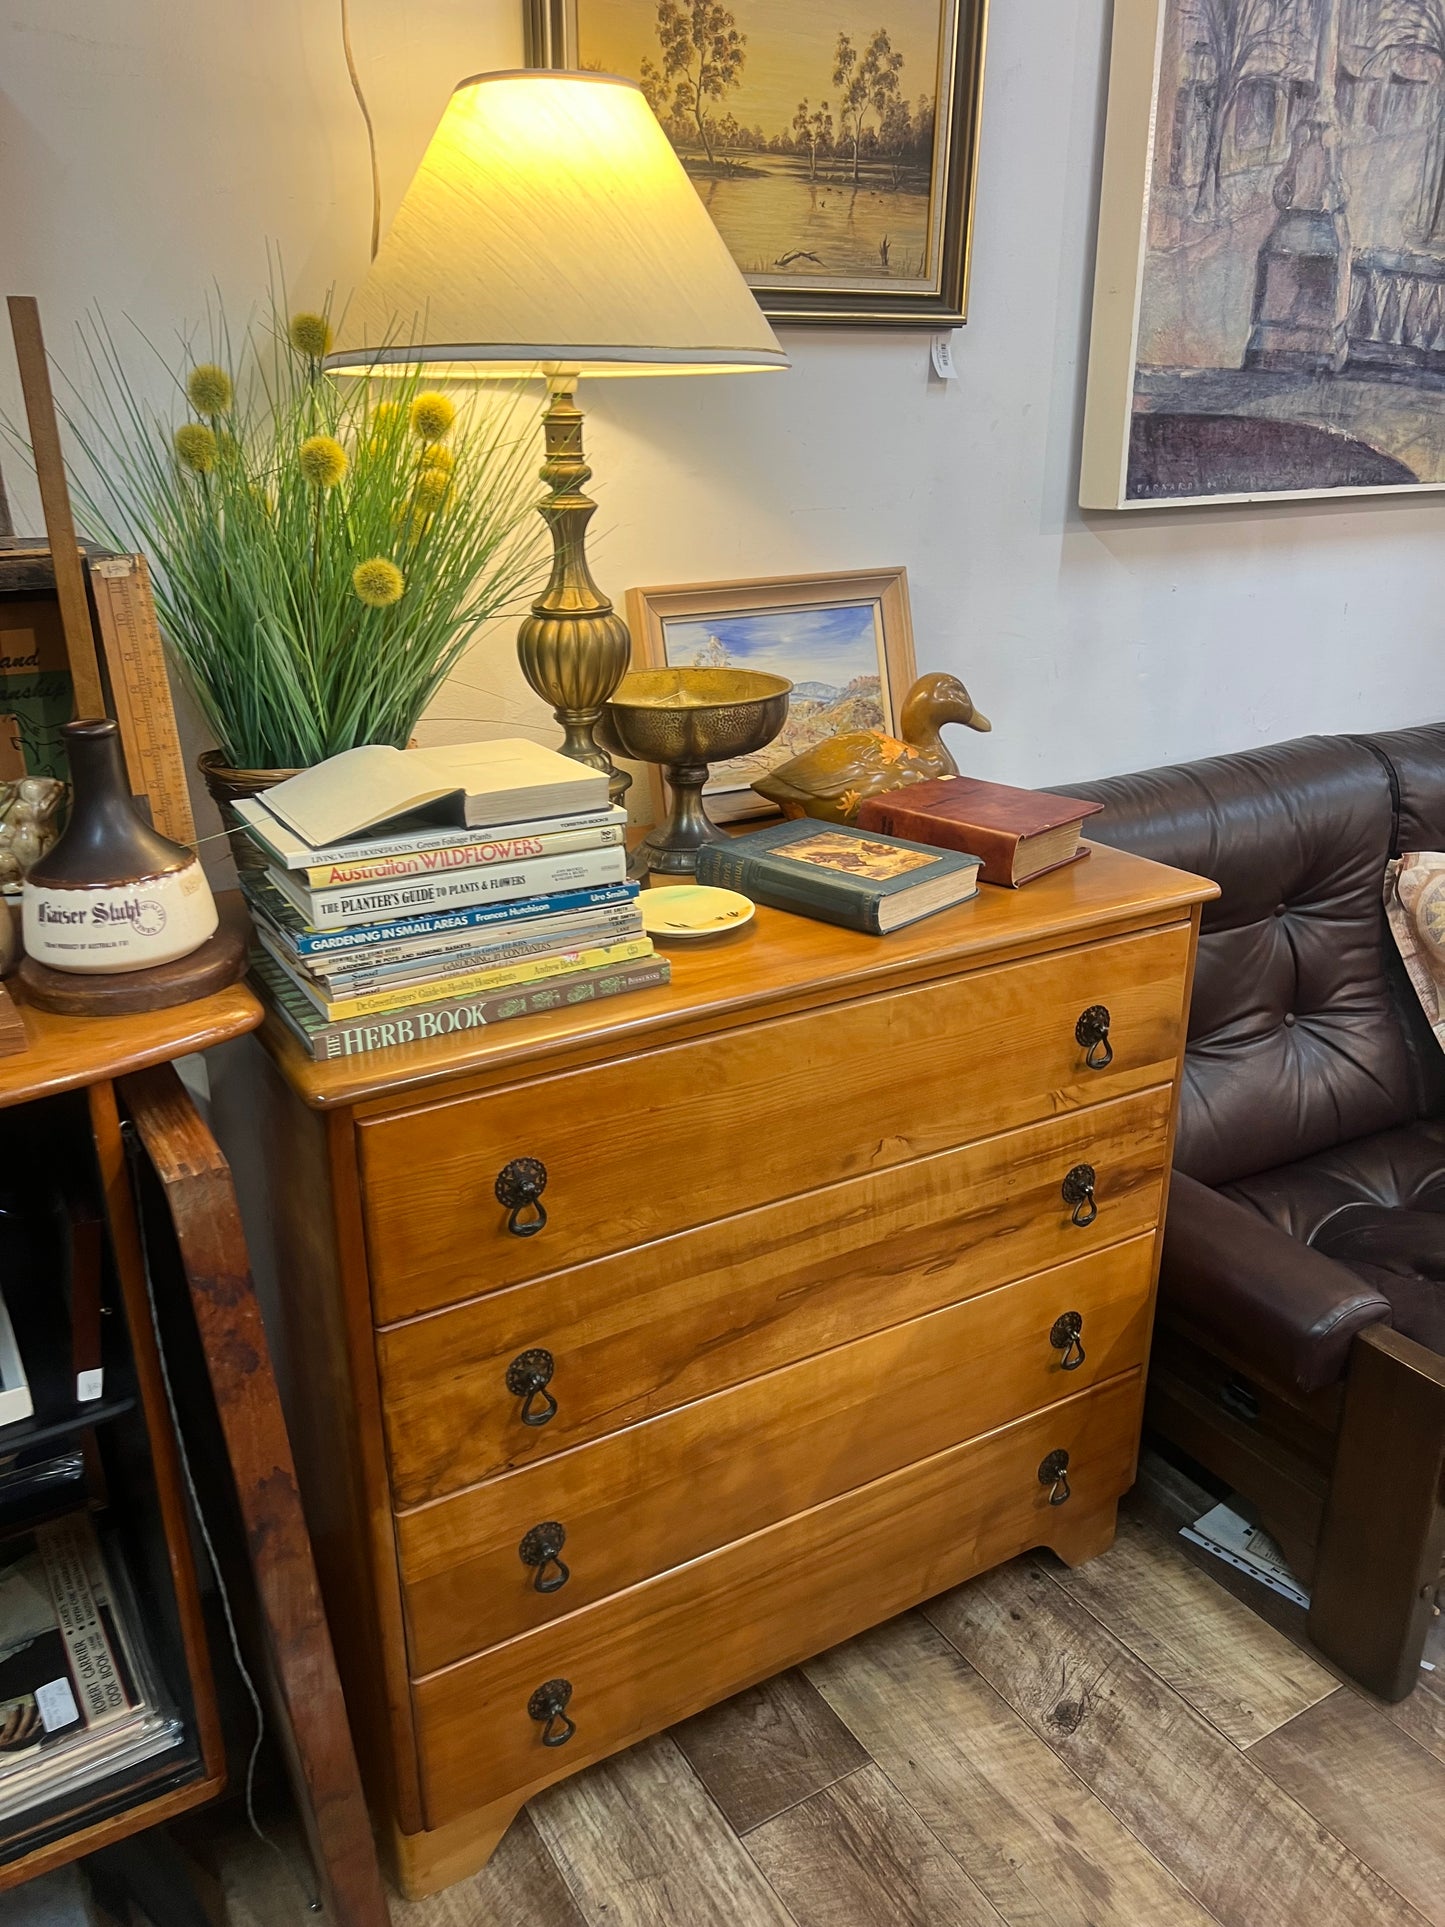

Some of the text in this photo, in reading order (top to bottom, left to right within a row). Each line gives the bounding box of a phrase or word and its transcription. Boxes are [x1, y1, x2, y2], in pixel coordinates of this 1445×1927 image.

[417, 840, 440, 850] Green
[442, 833, 468, 845] Foliage
[469, 832, 492, 842] Plants
[329, 838, 544, 884] Australian WILDFLOWERS
[321, 875, 526, 914] THE PLANTER'S GUIDE TO PLANTS & FLOWERS
[92, 899, 141, 926] Stuhl
[310, 888, 629, 951] GARDENING IN SMALL AREAS Frances Hutchison Ure Smith
[337, 961, 373, 971] GARDENING
[416, 947, 442, 956] HANGING
[445, 942, 471, 951] BASKETS
[352, 969, 378, 980] Sunset
[353, 979, 374, 988] Sunset
[419, 986, 438, 998] Guide
[476, 971, 516, 987] Houseplants
[534, 963, 559, 976] Andrew
[354, 987, 381, 997] Sunset
[327, 1001, 489, 1059] THE HERB BOOK
[73, 1639, 108, 1715] ROBERT CARRIER
[95, 1650, 114, 1679] BOOK
[103, 1679, 123, 1707] COOK
